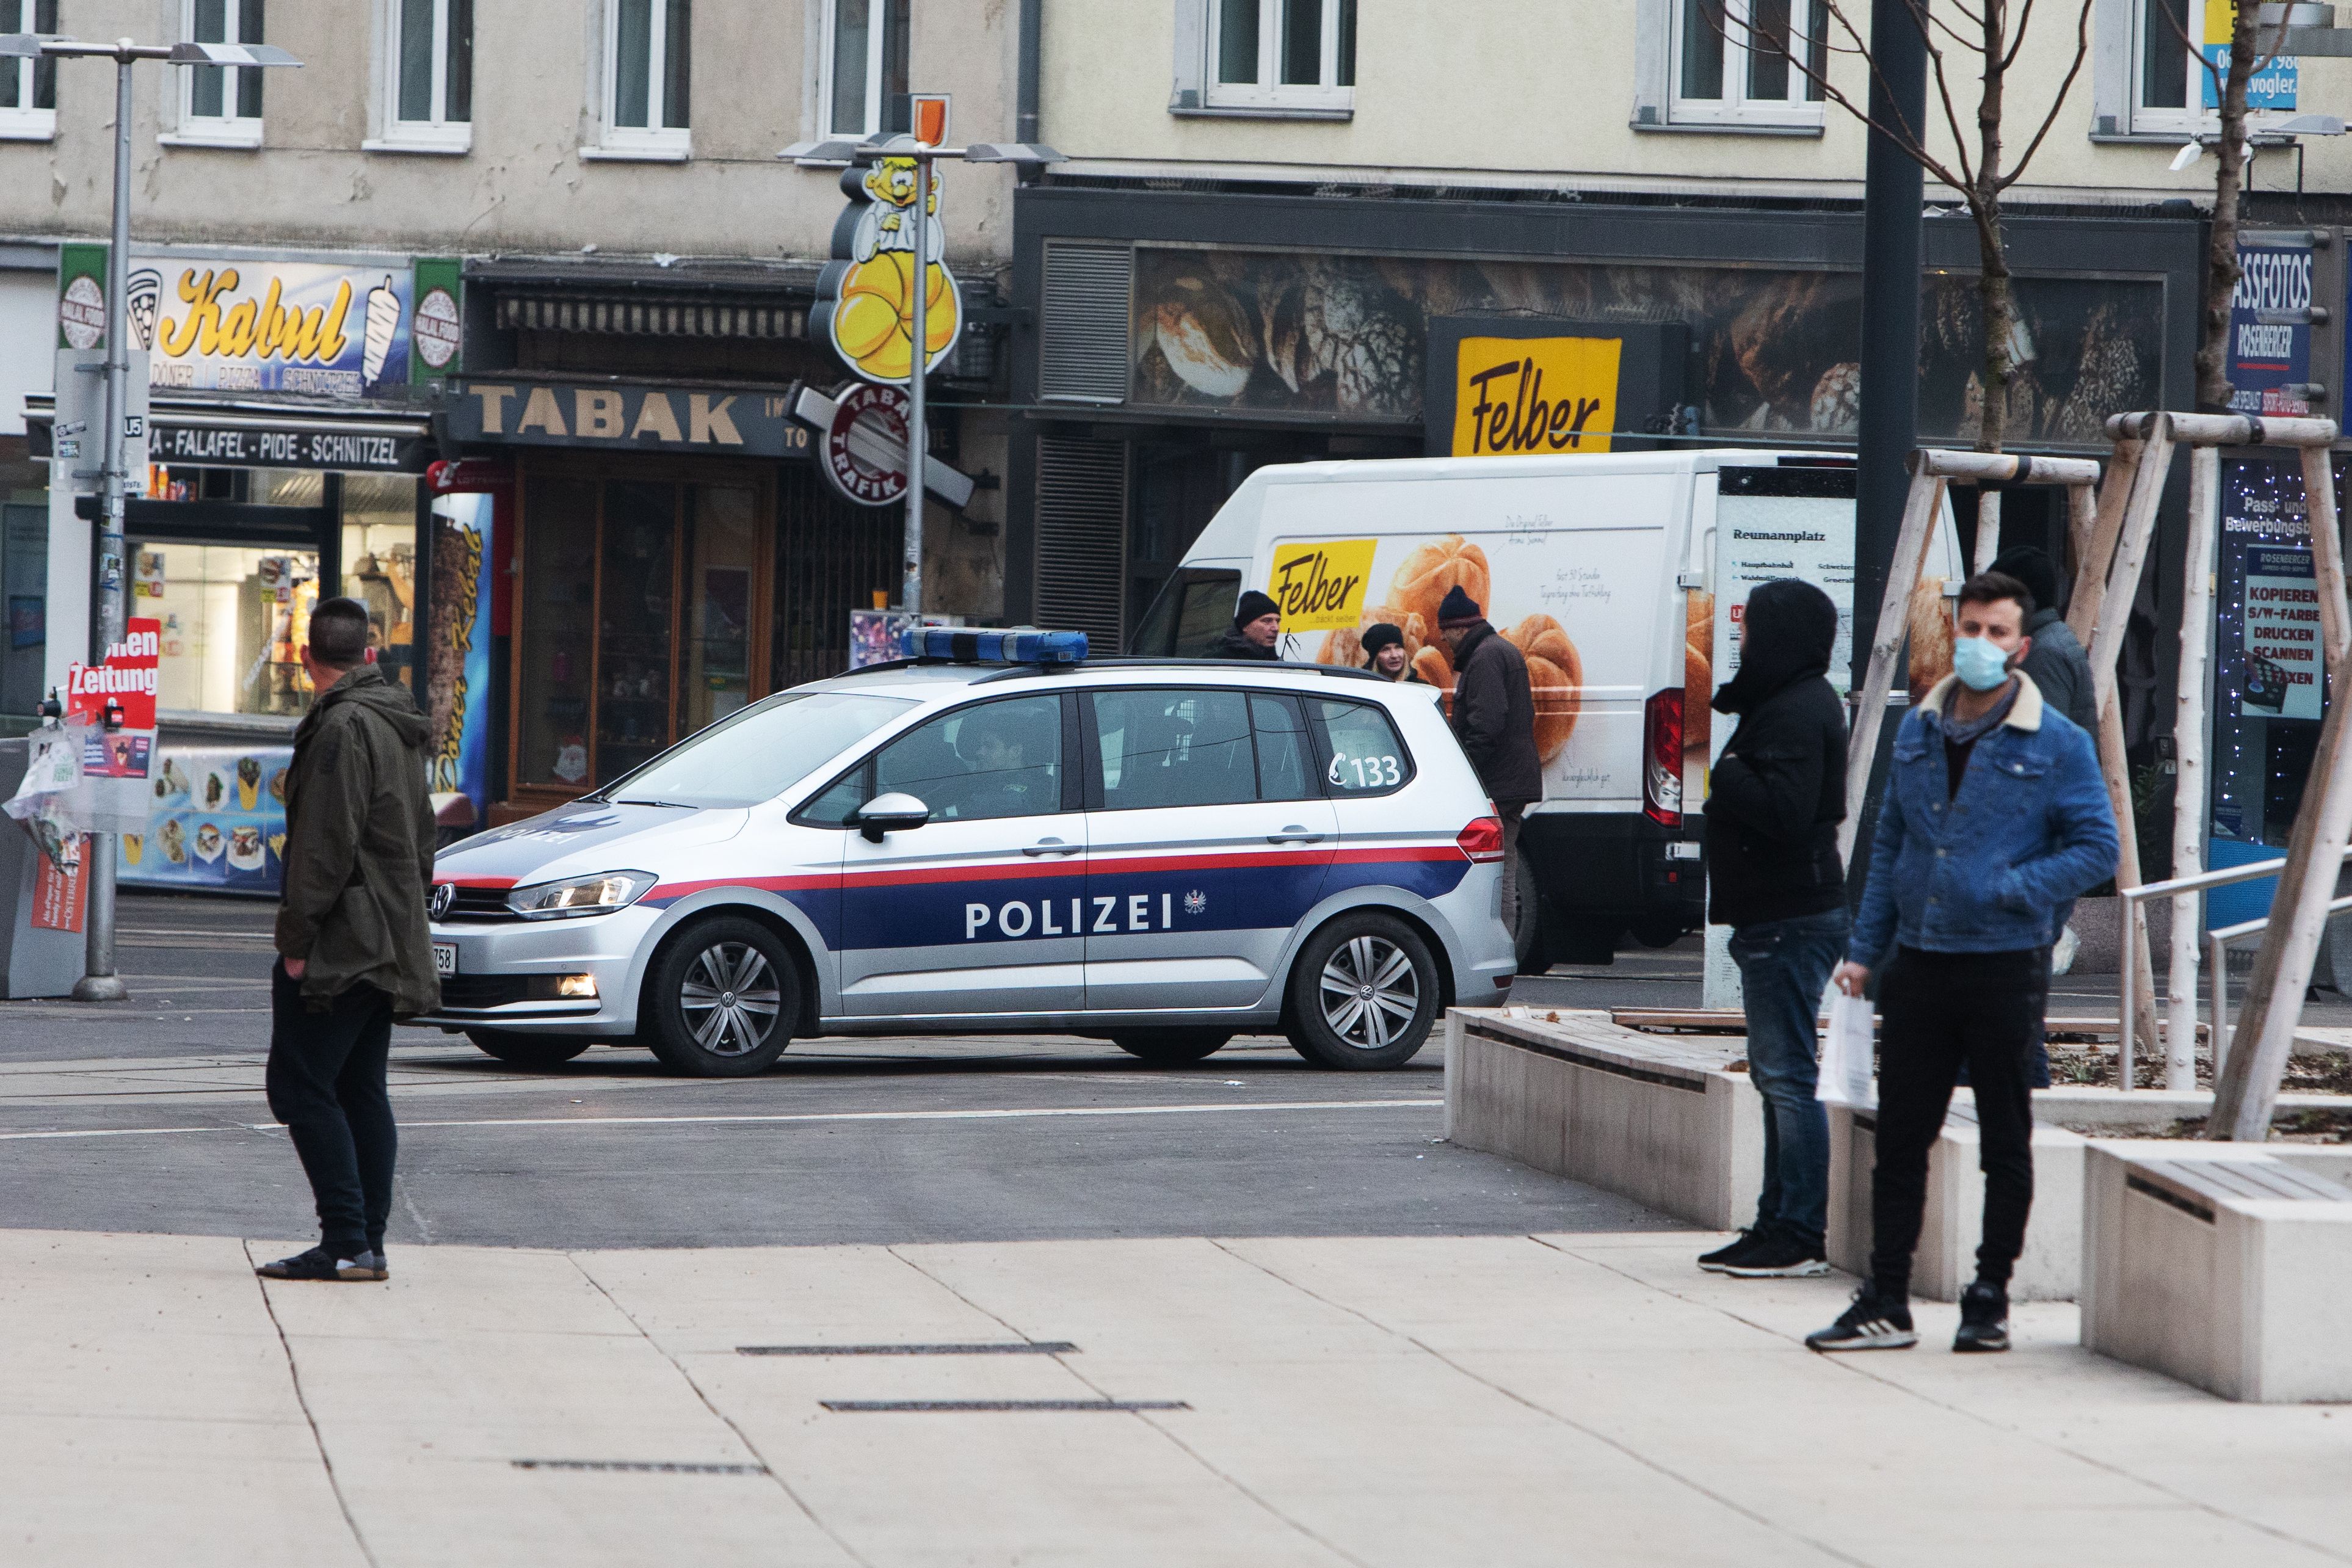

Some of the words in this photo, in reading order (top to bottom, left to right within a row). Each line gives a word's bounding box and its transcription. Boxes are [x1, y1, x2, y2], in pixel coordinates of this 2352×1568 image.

[2232, 253, 2312, 309] ASSFOTOS
[159, 267, 352, 361] Kabul
[2237, 324, 2292, 358] ROSENBERGER
[151, 363, 193, 387] DÖNER
[219, 366, 261, 390] PIZZA
[283, 368, 362, 396] SCHNITZEL
[468, 385, 744, 445] TABAK
[847, 388, 911, 419] TABA
[1469, 357, 1600, 454] Felber
[125, 418, 141, 435] U5
[175, 430, 245, 457] FALAFEL
[260, 433, 298, 460] PIDE
[311, 435, 399, 465] SCHNITZEL
[833, 431, 900, 498] TRAFIK
[1733, 529, 1826, 543] Reumannplatz
[1741, 561, 1794, 569] Hauptbahnhof
[1278, 551, 1359, 615] Felber
[2249, 586, 2319, 603] KOPIEREN
[2248, 606, 2320, 622] S/W-FARBE
[2254, 626, 2314, 641] DRUCKEN
[2253, 645, 2314, 661] SCANNEN
[70, 664, 159, 696] Zeitung
[2272, 672, 2314, 685] FAXEN
[1350, 755, 1401, 787] 133
[966, 893, 1172, 938] POLIZEI
[434, 948, 451, 968] 758
